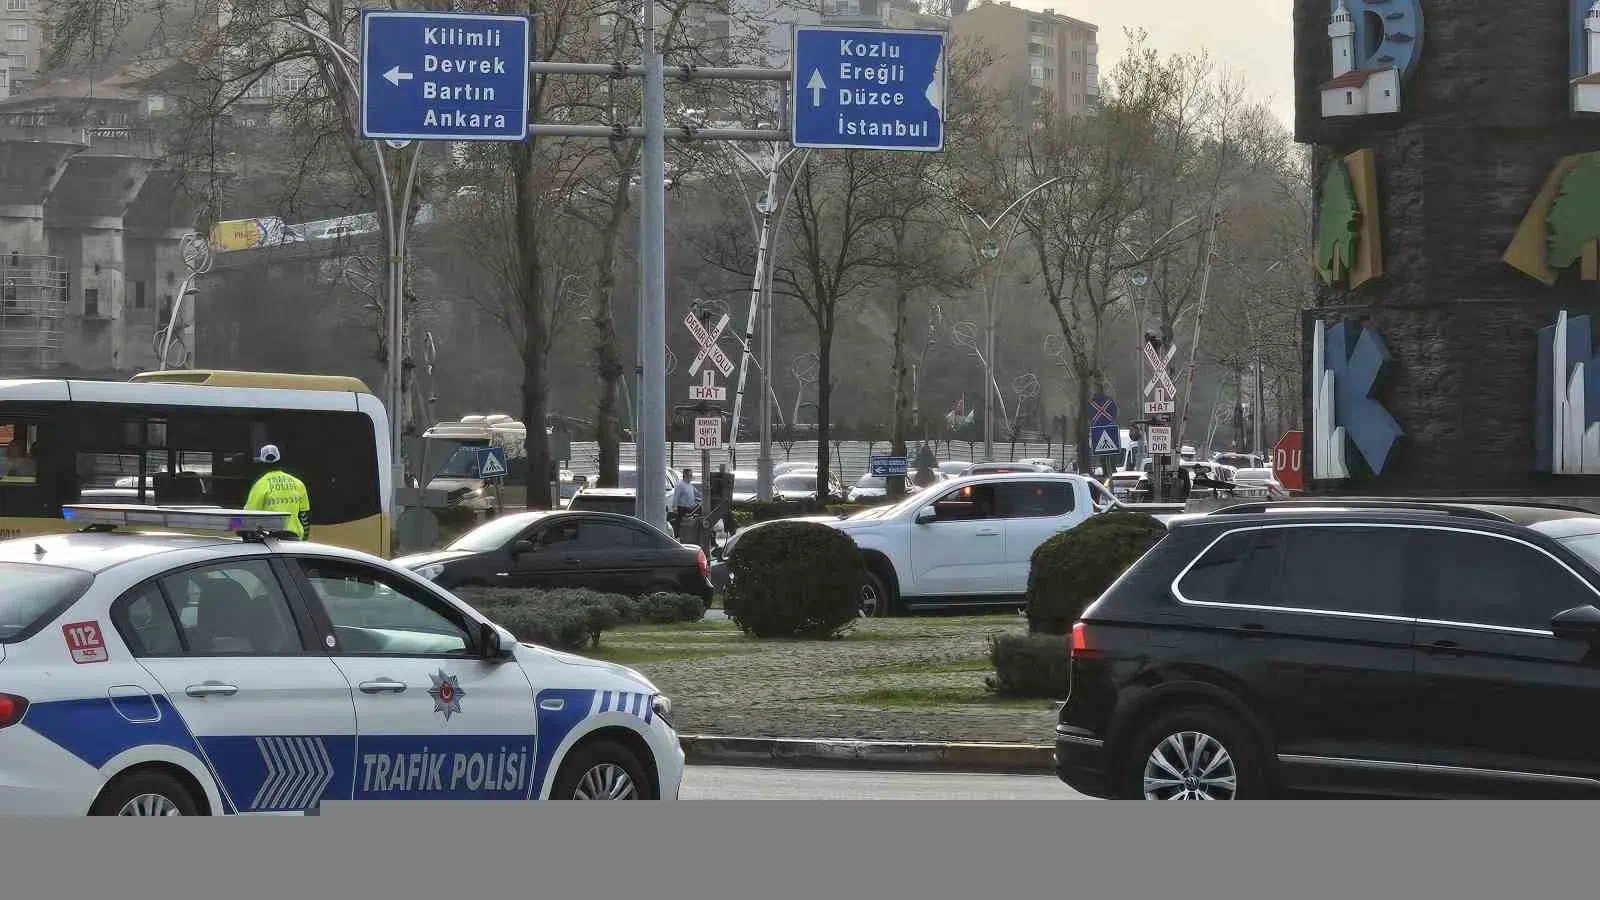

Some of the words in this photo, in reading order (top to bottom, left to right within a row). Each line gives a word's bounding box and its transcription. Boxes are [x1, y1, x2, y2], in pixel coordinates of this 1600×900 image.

[424, 27, 501, 47] Kilimli
[840, 39, 901, 58] Kozlu
[424, 54, 505, 74] Devrek
[840, 62, 904, 85] Ereğli
[423, 81, 495, 101] Bartın
[839, 88, 904, 105] Düzce
[423, 109, 505, 128] Ankara
[838, 113, 928, 137] İstanbul
[696, 387, 720, 398] HAT
[1149, 402, 1169, 412] HAT
[699, 437, 717, 446] DUR
[1152, 443, 1168, 451] DUR
[1276, 449, 1302, 471] DU
[69, 625, 99, 647] 112
[363, 746, 446, 791] TRAFİK
[450, 746, 527, 791] POLİSİ
